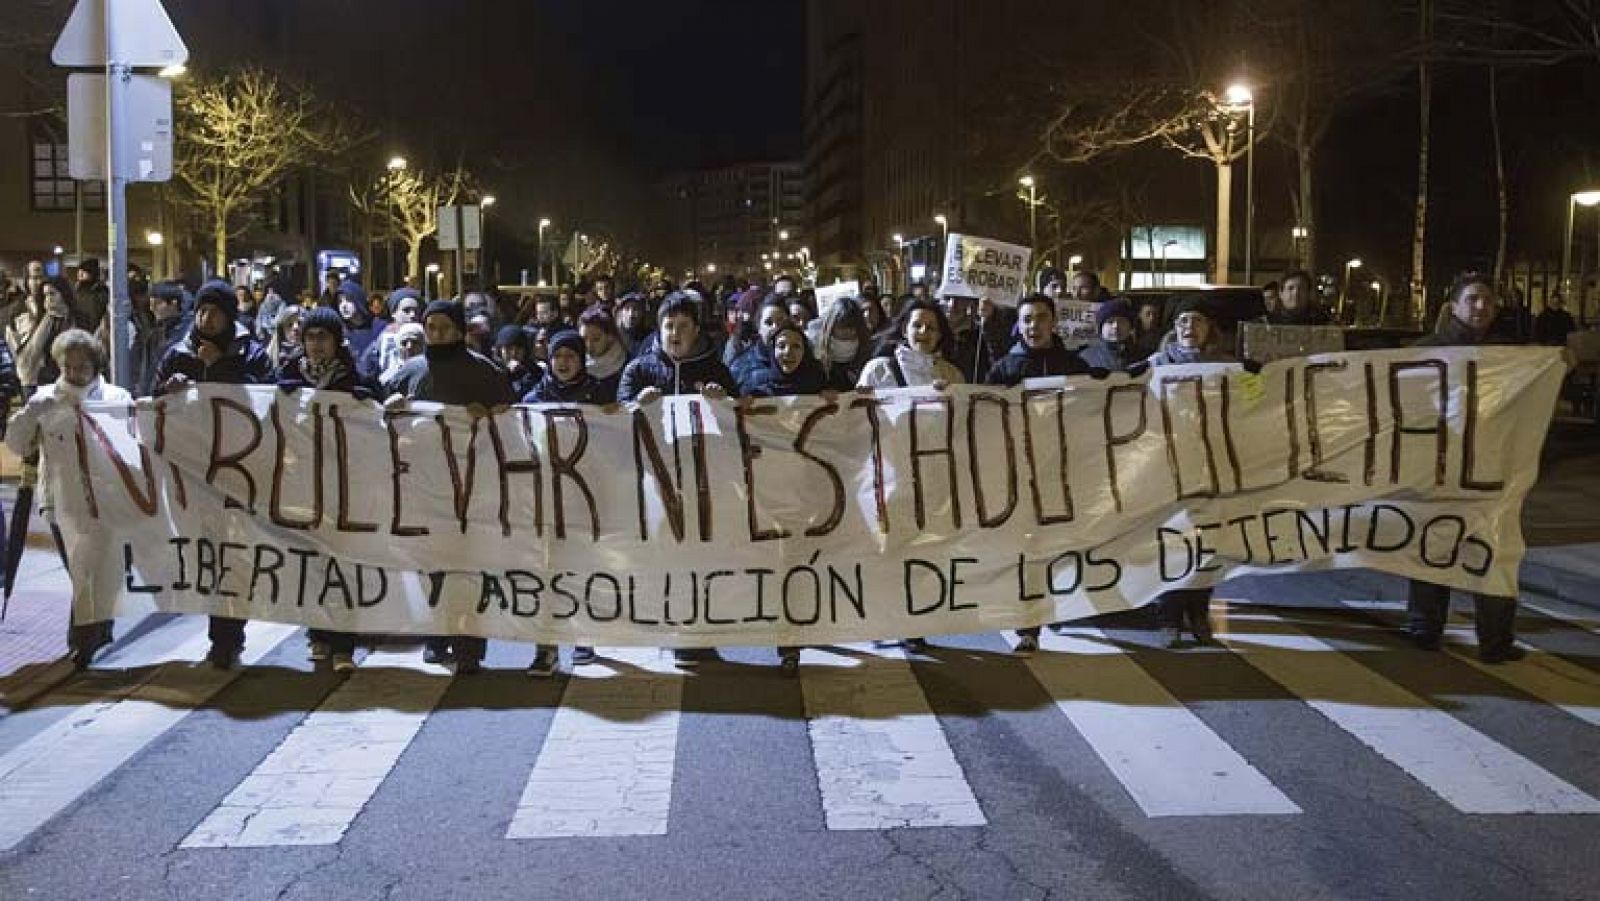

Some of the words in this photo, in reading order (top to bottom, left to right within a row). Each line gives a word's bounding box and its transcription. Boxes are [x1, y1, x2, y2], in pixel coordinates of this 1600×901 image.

[75, 401, 188, 519] NI
[206, 397, 601, 541] BULEVAR
[633, 400, 713, 542] NI
[734, 386, 1075, 542] ESTADO
[1103, 359, 1504, 512] POLICIAL
[124, 537, 388, 609] LIBERTAD
[476, 550, 866, 626] ABSOLUCIÓN
[904, 558, 980, 616] DE
[1018, 550, 1122, 602] LOS
[1157, 504, 1493, 582] DETENIDOS
